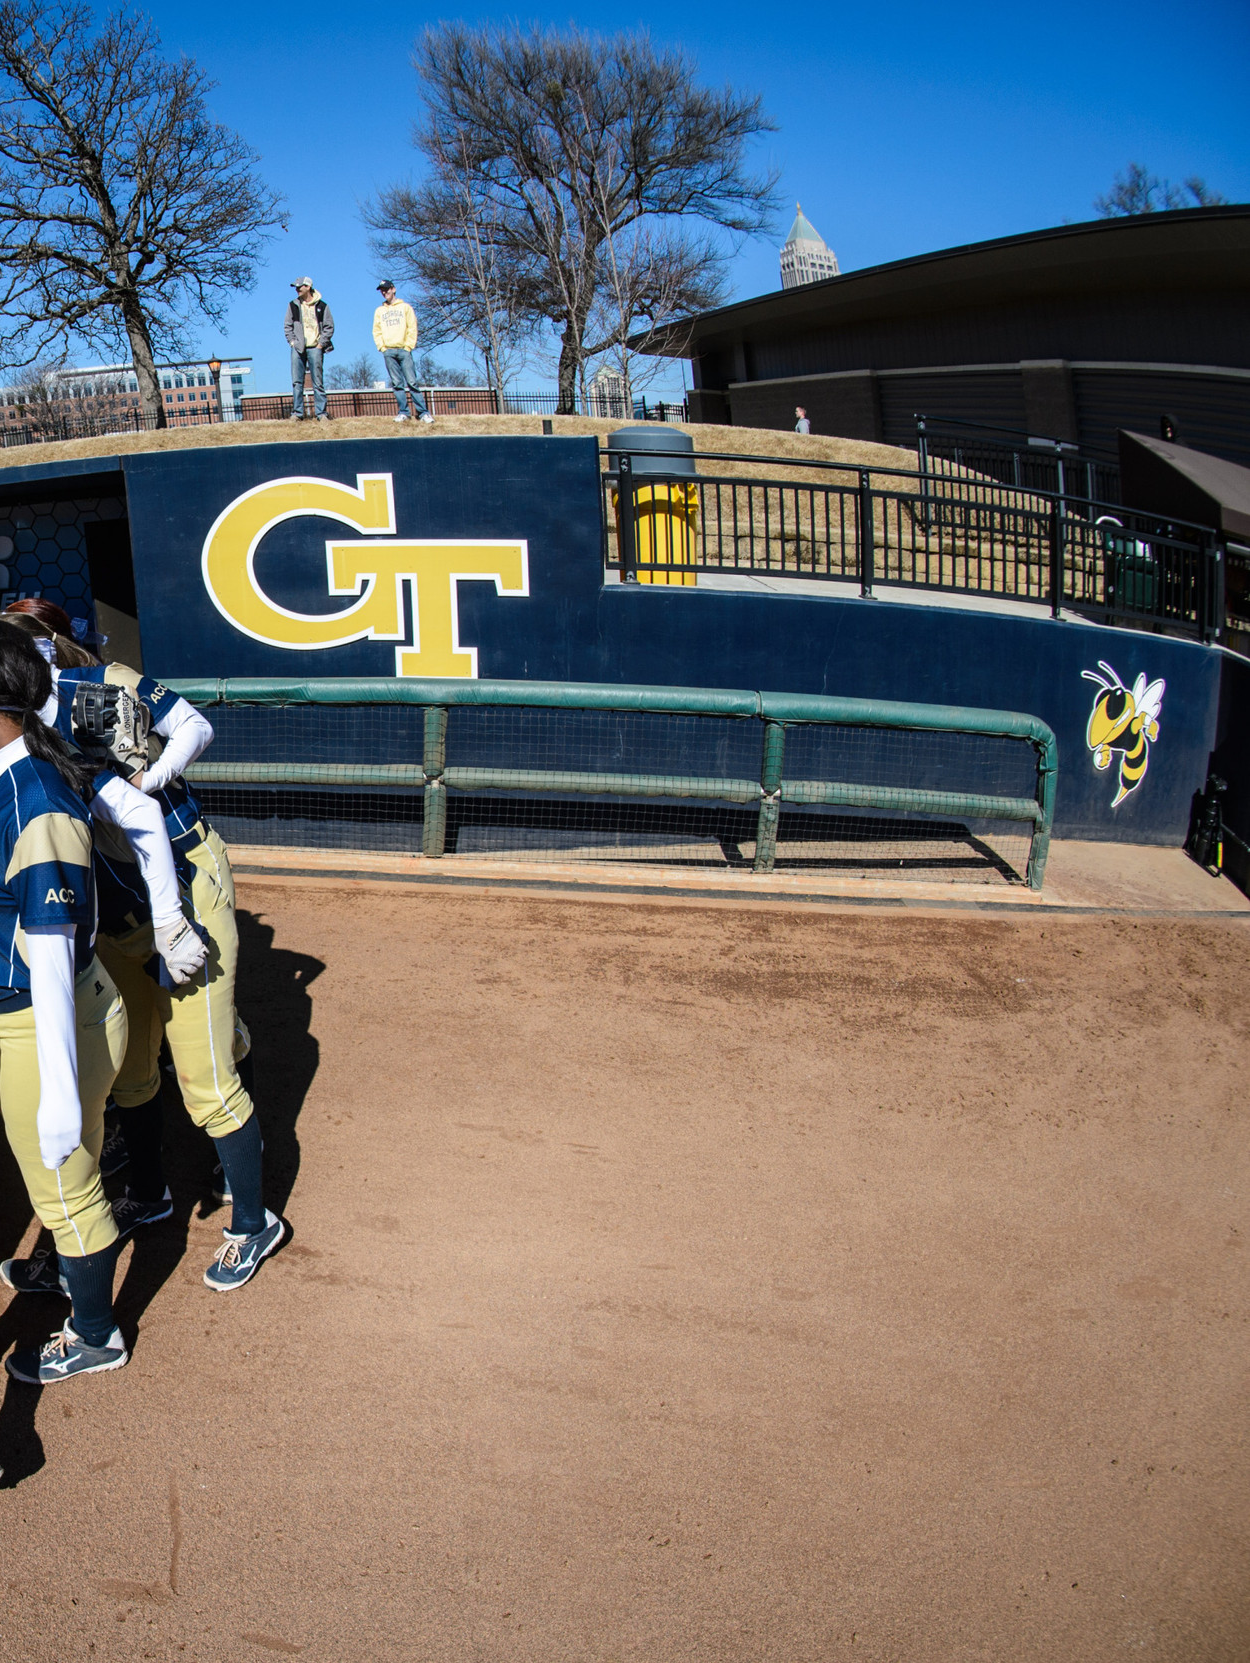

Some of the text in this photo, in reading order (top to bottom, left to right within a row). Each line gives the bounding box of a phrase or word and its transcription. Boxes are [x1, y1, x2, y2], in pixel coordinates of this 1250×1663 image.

[200, 472, 530, 679] GT
[150, 684, 168, 704] ACC
[44, 887, 75, 904] ACC
